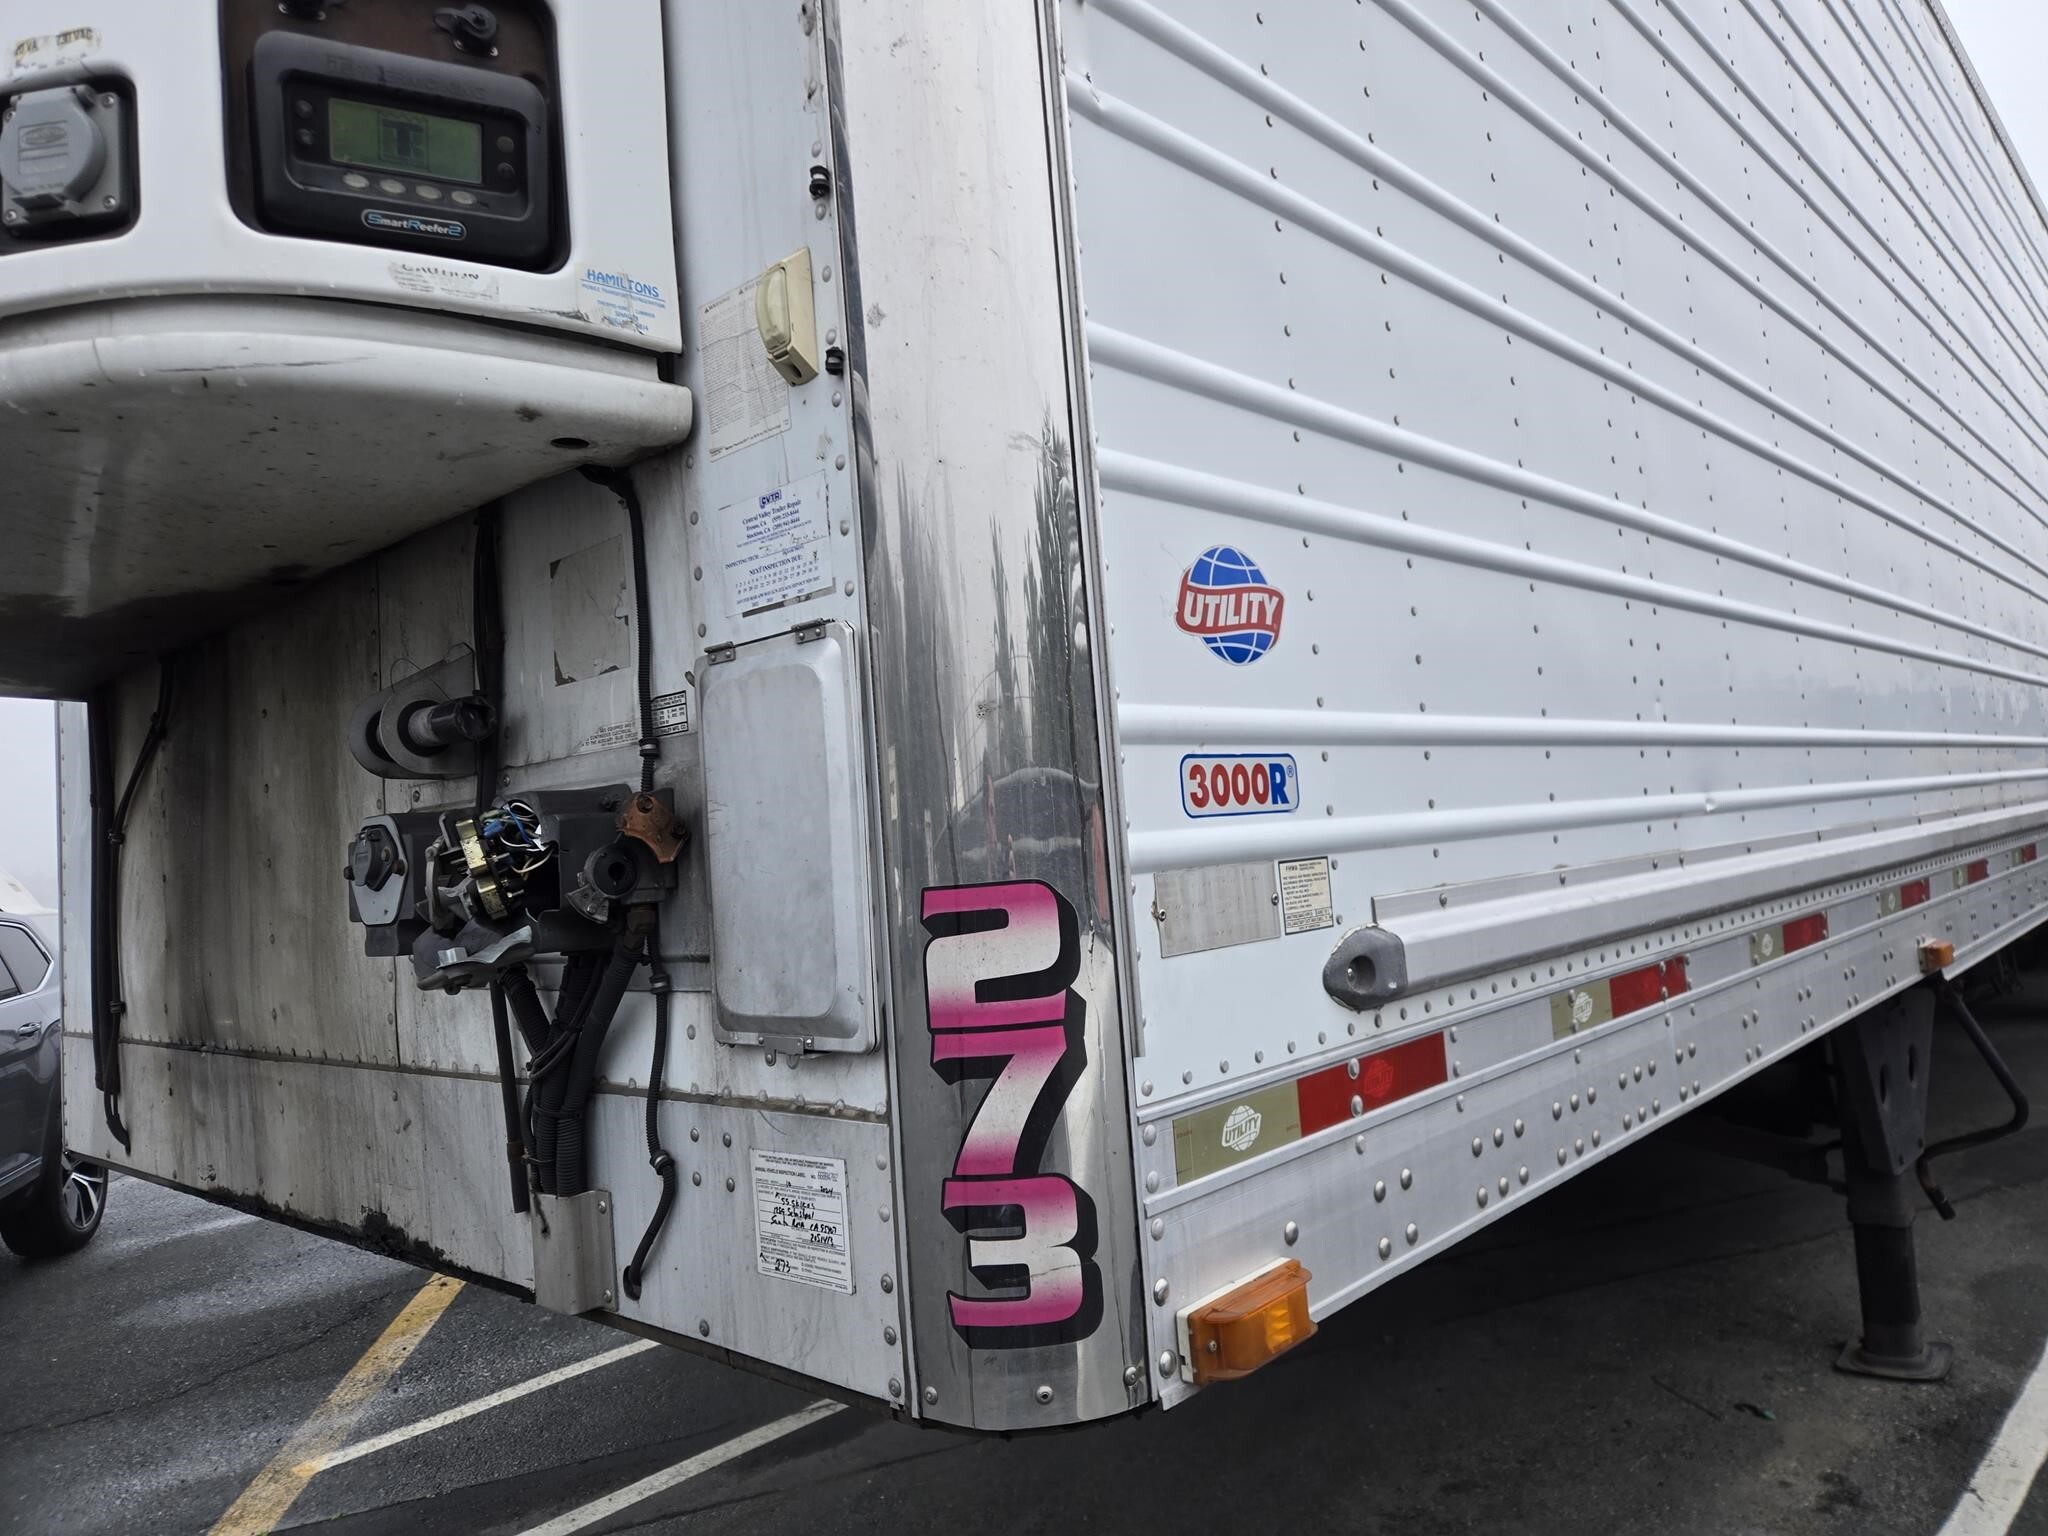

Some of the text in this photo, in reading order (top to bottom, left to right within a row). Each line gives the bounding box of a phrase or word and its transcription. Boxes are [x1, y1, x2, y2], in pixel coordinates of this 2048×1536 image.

[367, 213, 462, 236] SmartReefer2
[587, 268, 659, 298] HAMILTONS
[742, 499, 802, 526] Central Valley Trailer Repair
[1184, 590, 1279, 627] UTILITY
[921, 880, 1100, 1347] 273
[1225, 1116, 1259, 1144] UTILITY
[774, 1258, 791, 1274] 273
